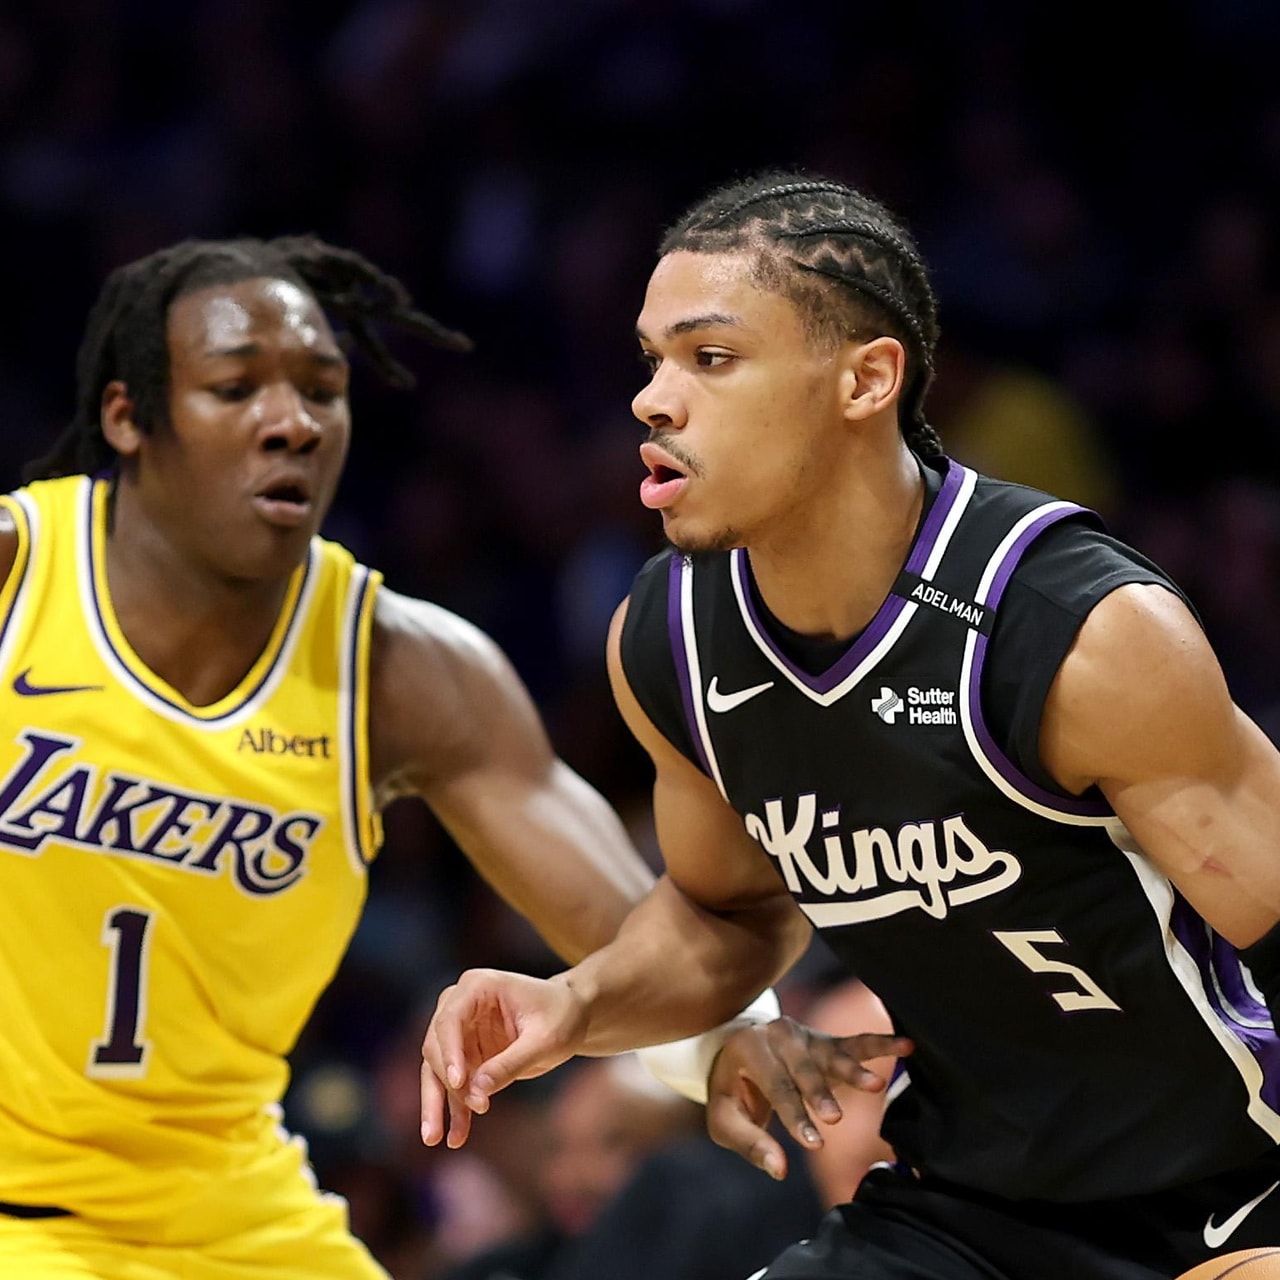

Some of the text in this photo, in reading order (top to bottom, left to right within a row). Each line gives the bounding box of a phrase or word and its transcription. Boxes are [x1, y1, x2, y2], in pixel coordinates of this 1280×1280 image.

[911, 583, 984, 626] ADELMAN
[907, 687, 954, 705] Sutter
[909, 707, 957, 725] Health
[237, 728, 332, 760] Albert
[745, 793, 1021, 920] Kings
[90, 907, 151, 1072] 1
[992, 928, 1122, 1012] 5
